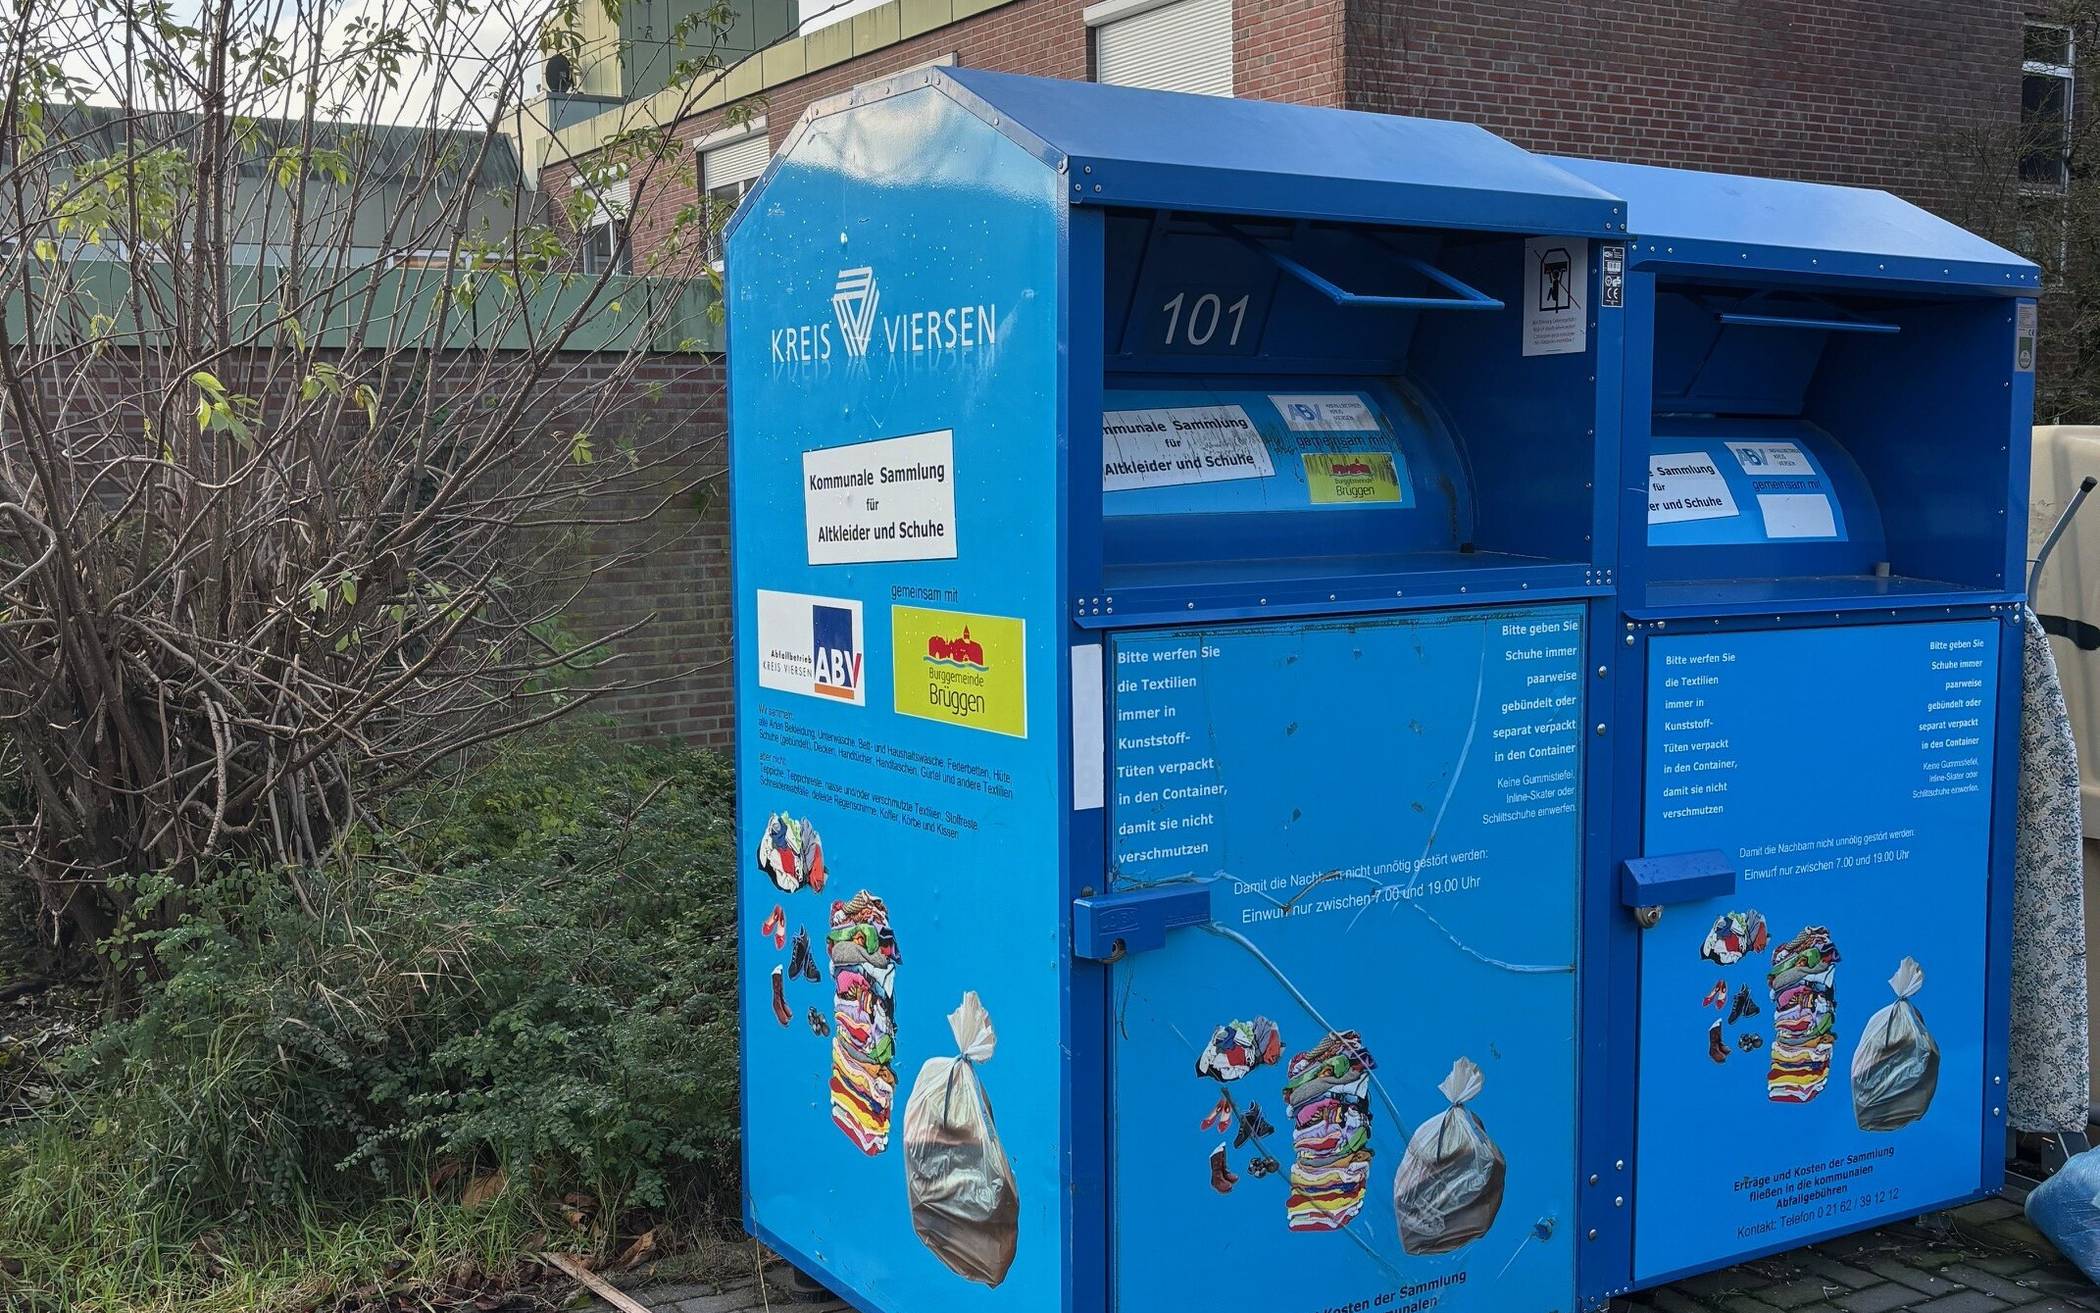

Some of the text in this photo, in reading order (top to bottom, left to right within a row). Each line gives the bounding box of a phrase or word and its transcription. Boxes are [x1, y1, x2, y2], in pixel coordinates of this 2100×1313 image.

[1162, 293, 1249, 346] 101
[772, 304, 996, 363] KREIS VIERSEN
[1172, 418, 1248, 431] Sammlung
[1165, 438, 1181, 448] für
[1296, 436, 1385, 449] gemeinsam mit
[1105, 454, 1254, 476] Altkleider und Schuhe
[1657, 465, 1716, 476] Sammlung
[809, 462, 945, 491] Kommunale Sammlung
[1653, 483, 1666, 492] für
[1752, 480, 1822, 492] gemeinsam mit
[866, 498, 880, 512] für
[1662, 497, 1723, 511] und Schuhe
[818, 520, 945, 543] Altkleider und Schuhe
[891, 584, 958, 604] gemeinsam mit
[1502, 620, 1578, 636] Bitte geben Sie
[1505, 646, 1578, 661] Schuhe immer
[1930, 639, 1984, 651] Bitte geben Sie
[771, 650, 812, 664] Abfallbetrieb
[1118, 646, 1220, 664] Bitte werfen Sie
[1666, 652, 1736, 665] Bitte werfen Sie
[763, 661, 812, 678] KREIS VIERSEN
[815, 647, 862, 689] ABV
[1931, 660, 1983, 670] Schuhe immer
[928, 666, 984, 687] Burggemeinde
[1118, 676, 1197, 693] die Textilien
[1527, 671, 1577, 687] paarweise
[1665, 675, 1719, 688] die Textilien
[1946, 679, 1982, 691] paarweise
[929, 683, 985, 717] Brüggen
[1501, 695, 1577, 714] gebündelt oder
[1665, 698, 1704, 709] immer in
[1927, 698, 1982, 712] gebündelt oder
[1119, 706, 1176, 721] immer in
[1493, 720, 1576, 739] separat verpackt
[1665, 718, 1714, 731] Kunststoff-
[1919, 718, 1979, 732] separat verpackt
[1118, 732, 1191, 750] Kunststoff-
[1664, 739, 1729, 753] Tüten verpackt
[1922, 737, 1979, 750] in den Container
[1495, 744, 1576, 762] in den Container
[1117, 758, 1214, 778] Tüten verpackt
[1664, 759, 1738, 774] in den Container,
[1497, 777, 1521, 789] Keine
[1663, 782, 1728, 797] damit sie nicht
[1119, 783, 1228, 805] in den Container,
[1506, 787, 1575, 803] Inline-Skater oder
[1482, 808, 1536, 825] Schlittschuhe
[1663, 804, 1724, 819] verschmutzen
[1119, 813, 1214, 835] damit sie nicht
[1119, 842, 1209, 863] verschmutzen
[1740, 847, 1763, 858] Damit
[1764, 846, 1776, 855] die
[1816, 838, 1834, 849] nicht
[1234, 848, 1488, 895] Damit die nicht unnötig gestört werden:
[1744, 849, 1910, 881] Einwurf nur zwischen 7.00 und 19.00 Uhr
[1292, 902, 1312, 916] nur
[1316, 892, 1371, 913] zwischen
[1375, 886, 1400, 903] 7.00
[1403, 884, 1424, 899] und
[1428, 878, 1458, 895] 19.00
[1462, 875, 1481, 890] Uhr
[1734, 1146, 1895, 1192] Erträge und Kosten der Sammlung
[1750, 1164, 1873, 1202] fließen in die kommunalen
[1776, 1184, 1848, 1210] Abfallgebühren
[1737, 1187, 1899, 1239] Kontakt: Telefon 0 21 62 39 12 12
[1373, 1271, 1467, 1306] der Sammlung
